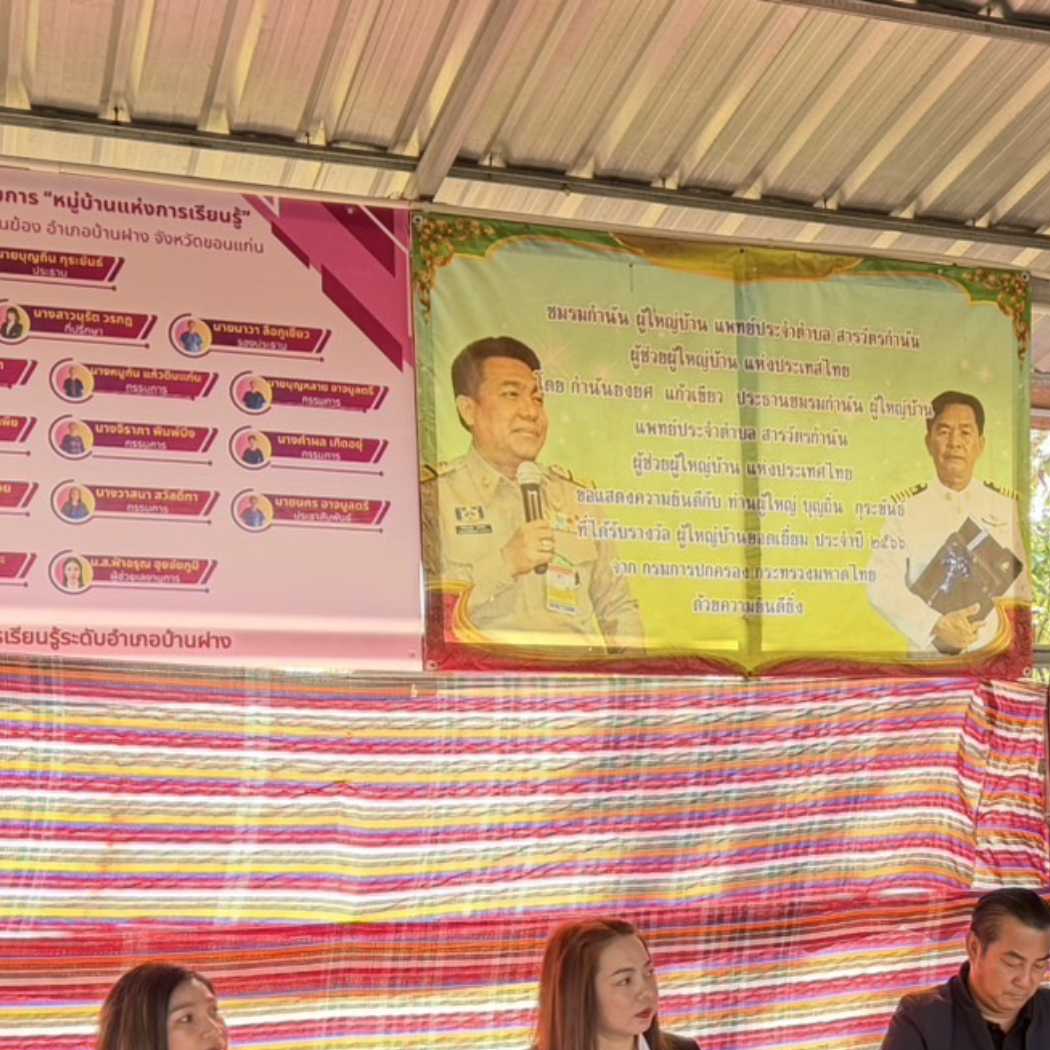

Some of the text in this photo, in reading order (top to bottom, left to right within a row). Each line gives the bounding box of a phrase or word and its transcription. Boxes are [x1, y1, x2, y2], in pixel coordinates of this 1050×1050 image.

[0, 189, 39, 206] การ
[46, 220, 149, 244] อำเภอบ้านฝาง
[154, 230, 264, 254] จังหวัดขอนแก่น
[0, 626, 232, 651] เรียนรู้ระดับอำเภอบ้านฝาง
